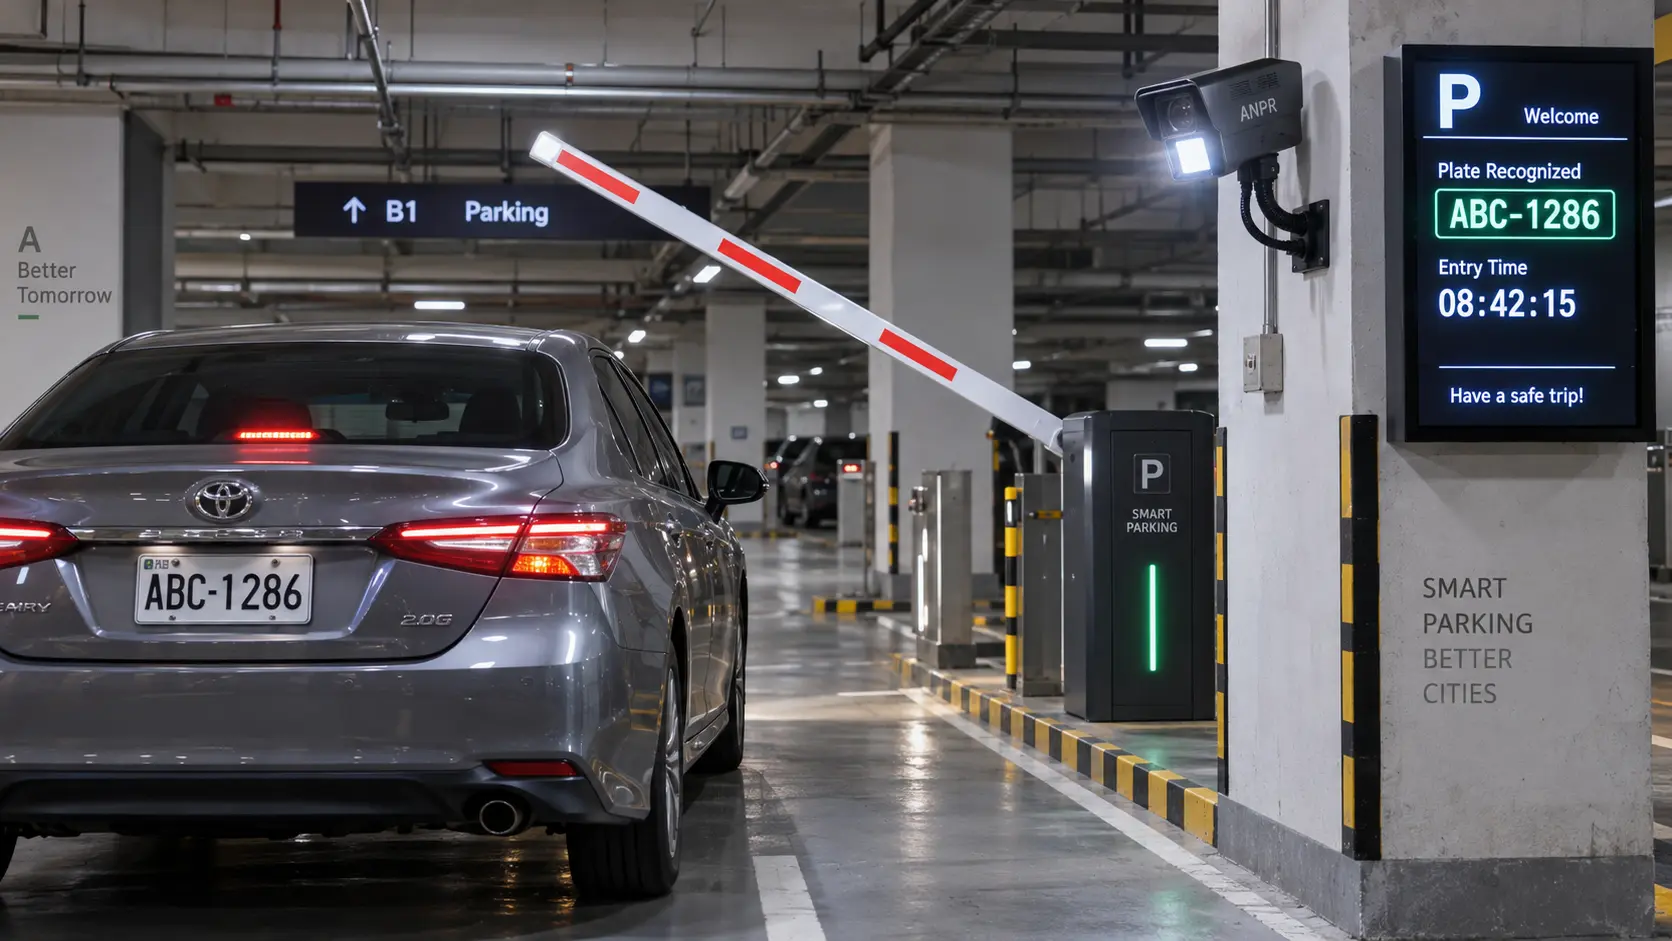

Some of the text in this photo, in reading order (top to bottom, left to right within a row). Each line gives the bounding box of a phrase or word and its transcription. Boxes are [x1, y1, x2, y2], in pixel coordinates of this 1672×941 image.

[1240, 97, 1278, 122] ANPR
[1439, 73, 1481, 129] P
[1523, 106, 1600, 125] Welcome
[1438, 162, 1581, 183] Plate Recognized
[386, 200, 549, 228] B1 Parking
[1449, 198, 1600, 230] ABC-1286
[18, 225, 42, 253] A
[18, 262, 77, 279] Better
[1438, 259, 1528, 280] Entry Time
[17, 287, 113, 304] Tomorrow
[1438, 288, 1576, 318] 08:42:15
[1450, 386, 1584, 408] Have a safe trip!
[1141, 459, 1164, 489] P
[1132, 508, 1173, 520] SMART
[1126, 522, 1178, 533] PARKING
[144, 573, 302, 611] ABC-1286
[1423, 577, 1508, 599] SMART
[400, 613, 453, 626] 2.0G
[1423, 612, 1533, 635] PARKING
[1424, 648, 1512, 669] BETTER
[1423, 682, 1497, 704] CITIES
